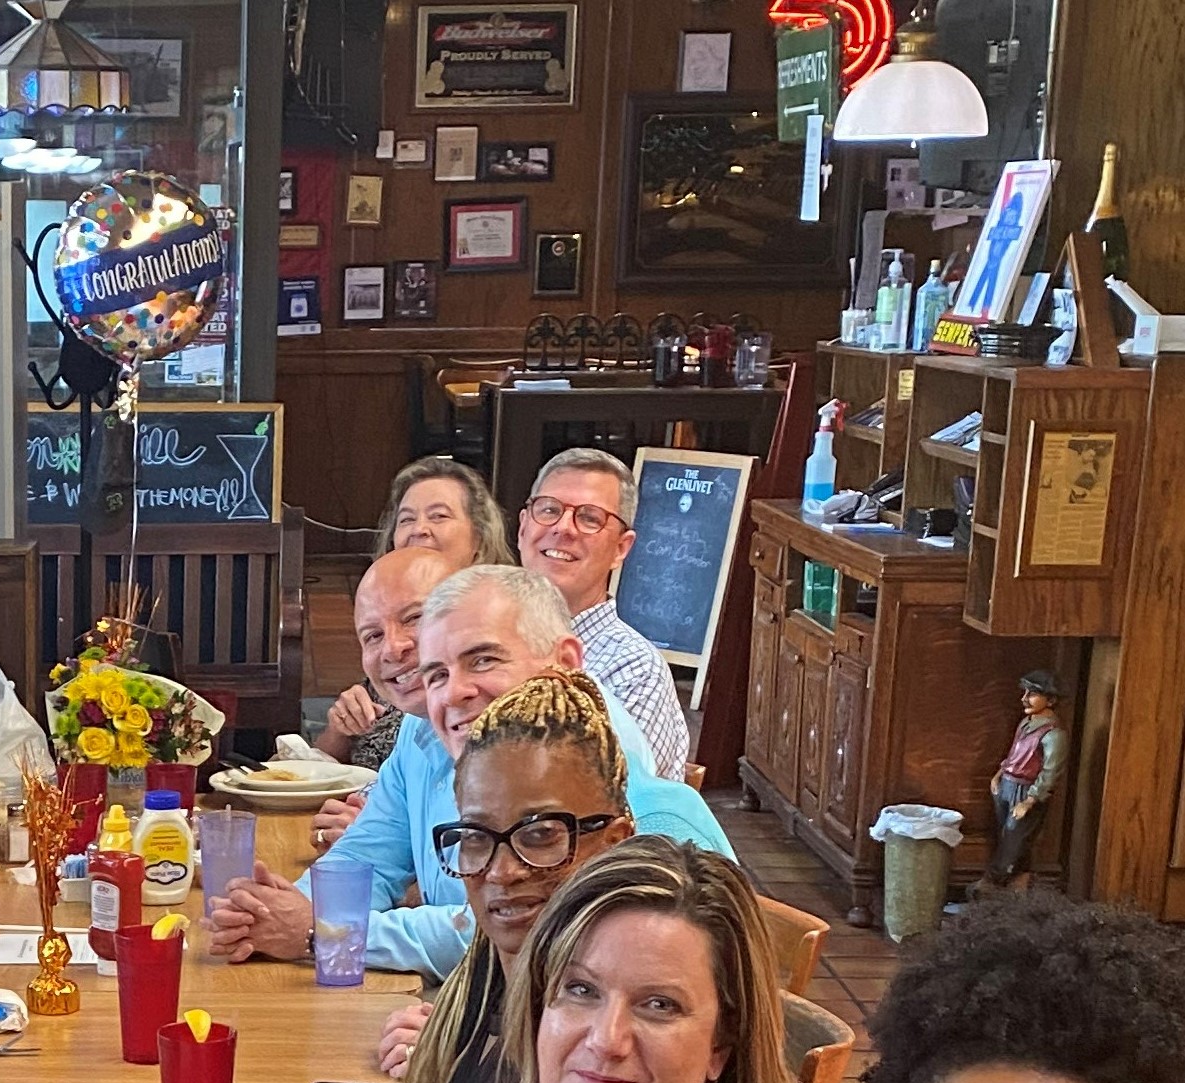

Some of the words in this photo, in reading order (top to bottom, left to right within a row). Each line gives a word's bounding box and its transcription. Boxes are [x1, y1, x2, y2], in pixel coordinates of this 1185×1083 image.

[441, 23, 552, 40] Budweiser
[440, 50, 500, 62] PROUDLY
[501, 49, 552, 61] SERVED
[82, 230, 221, 302] CONGRATULATIONS!
[684, 469, 700, 480] THE
[666, 477, 715, 495] GLENLIVET
